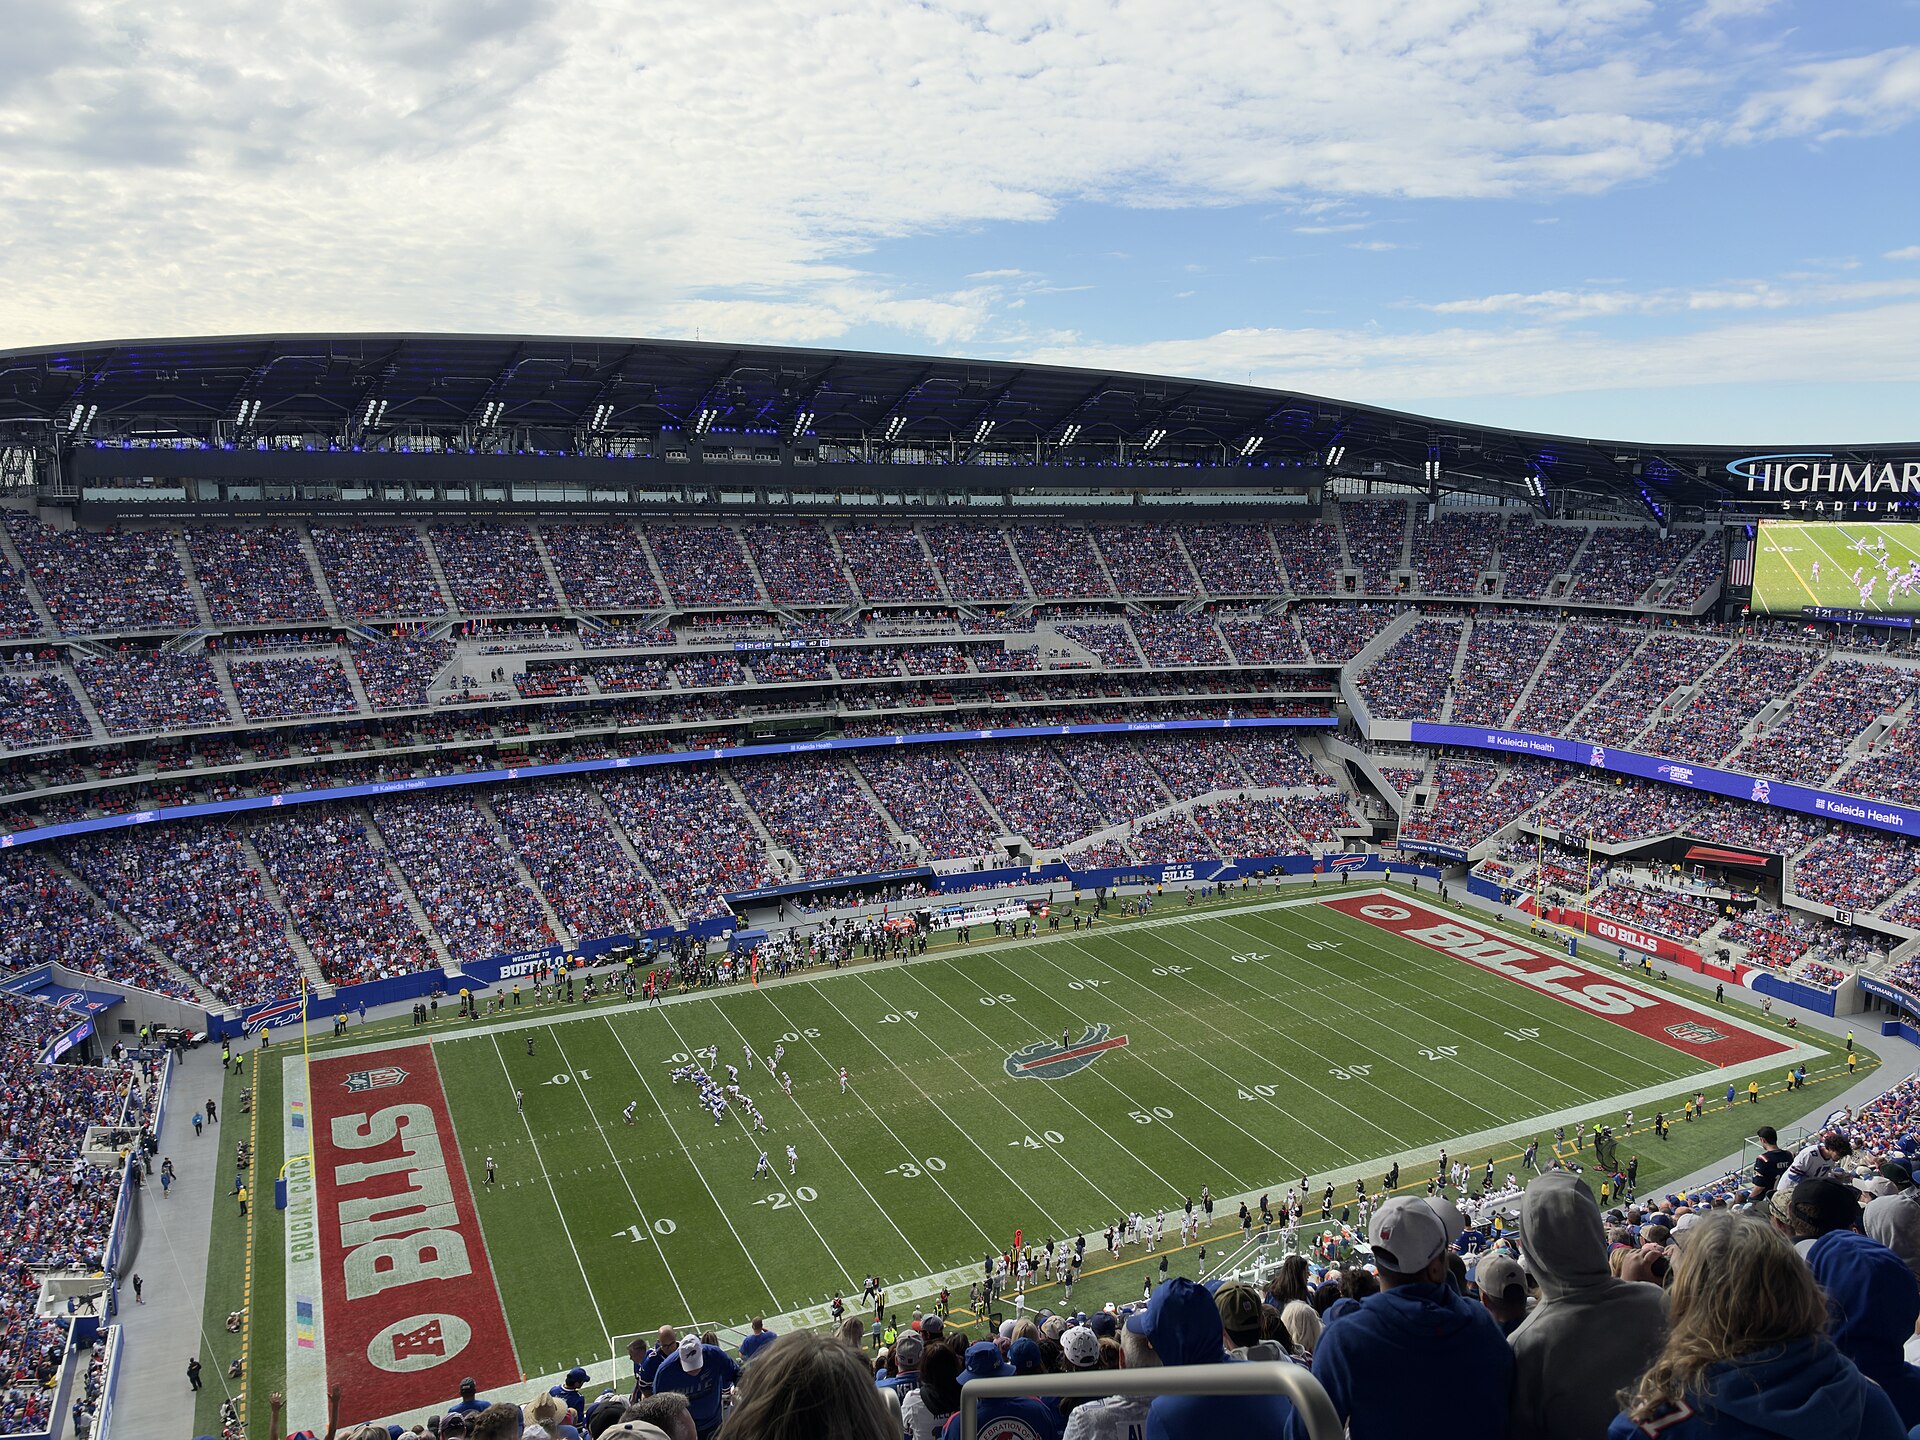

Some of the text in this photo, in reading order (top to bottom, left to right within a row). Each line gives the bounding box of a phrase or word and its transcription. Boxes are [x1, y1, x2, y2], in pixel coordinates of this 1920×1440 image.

[1783, 500, 1898, 512] STADIUM
[1822, 609, 1831, 618] 21
[1855, 612, 1864, 620] 17
[1497, 736, 1555, 752] Kaleida Health
[1670, 771, 1688, 780] CATCH
[1671, 766, 1693, 776] CRUCIAL
[380, 780, 426, 792] Kaleida Health
[1827, 800, 1903, 826] Kaleida Health
[1402, 843, 1428, 852] HIGHMARK
[1565, 835, 1583, 847] 0:47
[1161, 870, 1194, 881] BILLS
[1840, 913, 1849, 922] 13
[1598, 922, 1657, 952] GO BILLS
[1307, 941, 1335, 952] 10
[512, 952, 540, 963] WELCOME
[1231, 952, 1264, 964] 20
[500, 955, 564, 978] BUFFALO
[1152, 964, 1186, 976] 30
[1401, 925, 1660, 1014] BILLS
[1068, 979, 1099, 991] 40
[979, 994, 1016, 1006] 50
[885, 1010, 919, 1024] 40
[782, 1028, 822, 1044] 30
[1504, 1027, 1538, 1042] 10
[1418, 1045, 1458, 1061] 20
[552, 1069, 592, 1086] 10
[1328, 1063, 1369, 1080] 30
[1236, 1084, 1276, 1102] 40
[1128, 1106, 1174, 1124] 50
[1024, 1130, 1065, 1150] 40
[899, 1156, 947, 1178] 30
[1814, 1164, 1831, 1177] 17
[331, 1103, 472, 1301] BILLS
[766, 1186, 818, 1210] 20
[289, 1152, 314, 1263] CRUCIAL CATCH
[627, 1218, 677, 1243] 10
[1468, 1243, 1477, 1253] 17
[392, 1319, 446, 1362] A
[1021, 1428, 1030, 1438] OF
